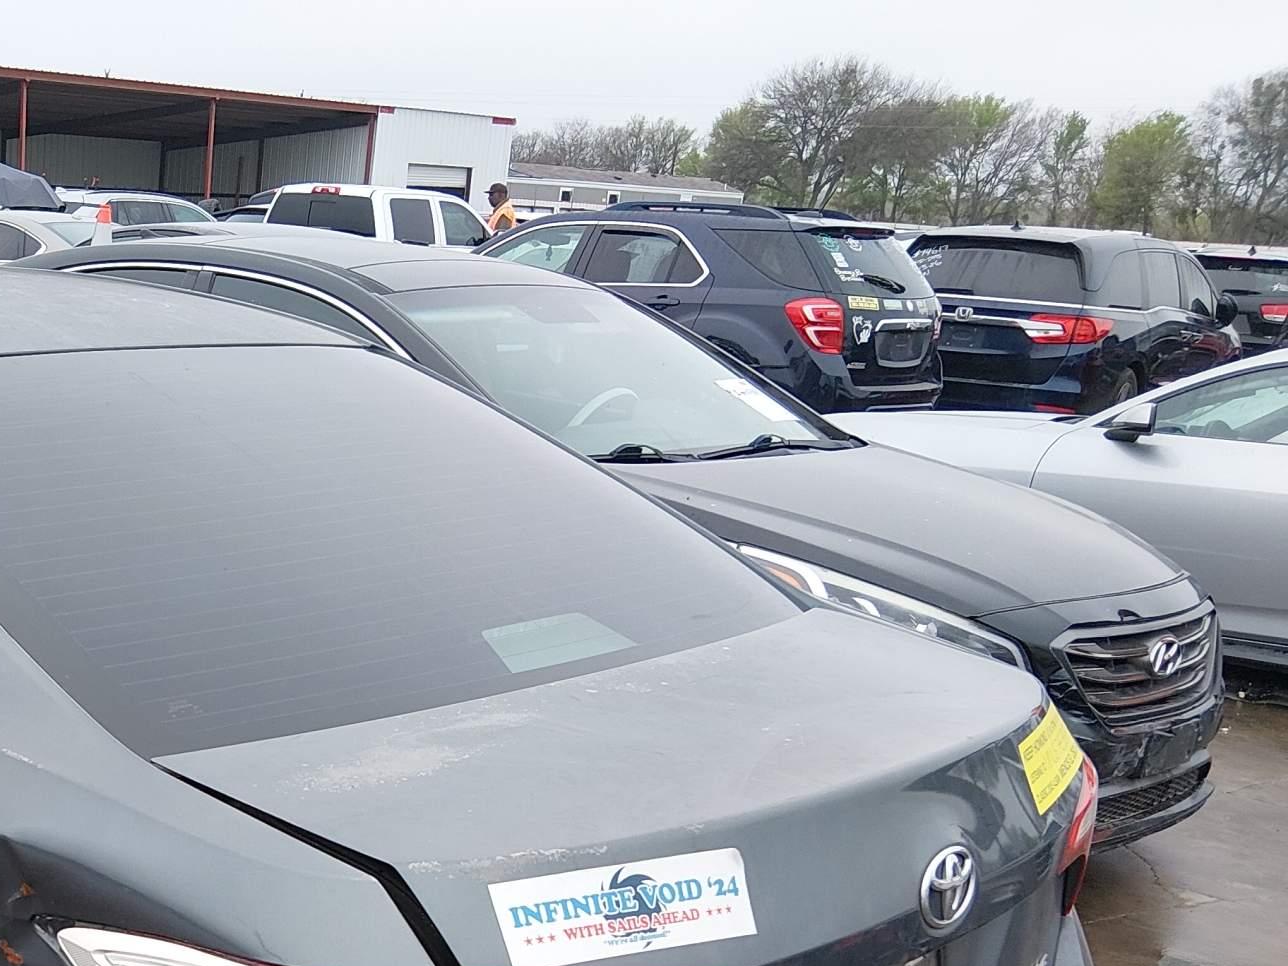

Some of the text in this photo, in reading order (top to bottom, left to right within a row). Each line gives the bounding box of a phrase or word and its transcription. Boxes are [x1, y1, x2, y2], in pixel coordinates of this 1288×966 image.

[509, 890, 638, 928] INFINITE
[638, 878, 703, 907] VOID
[563, 908, 700, 941] WITH SAILS AHEAD
